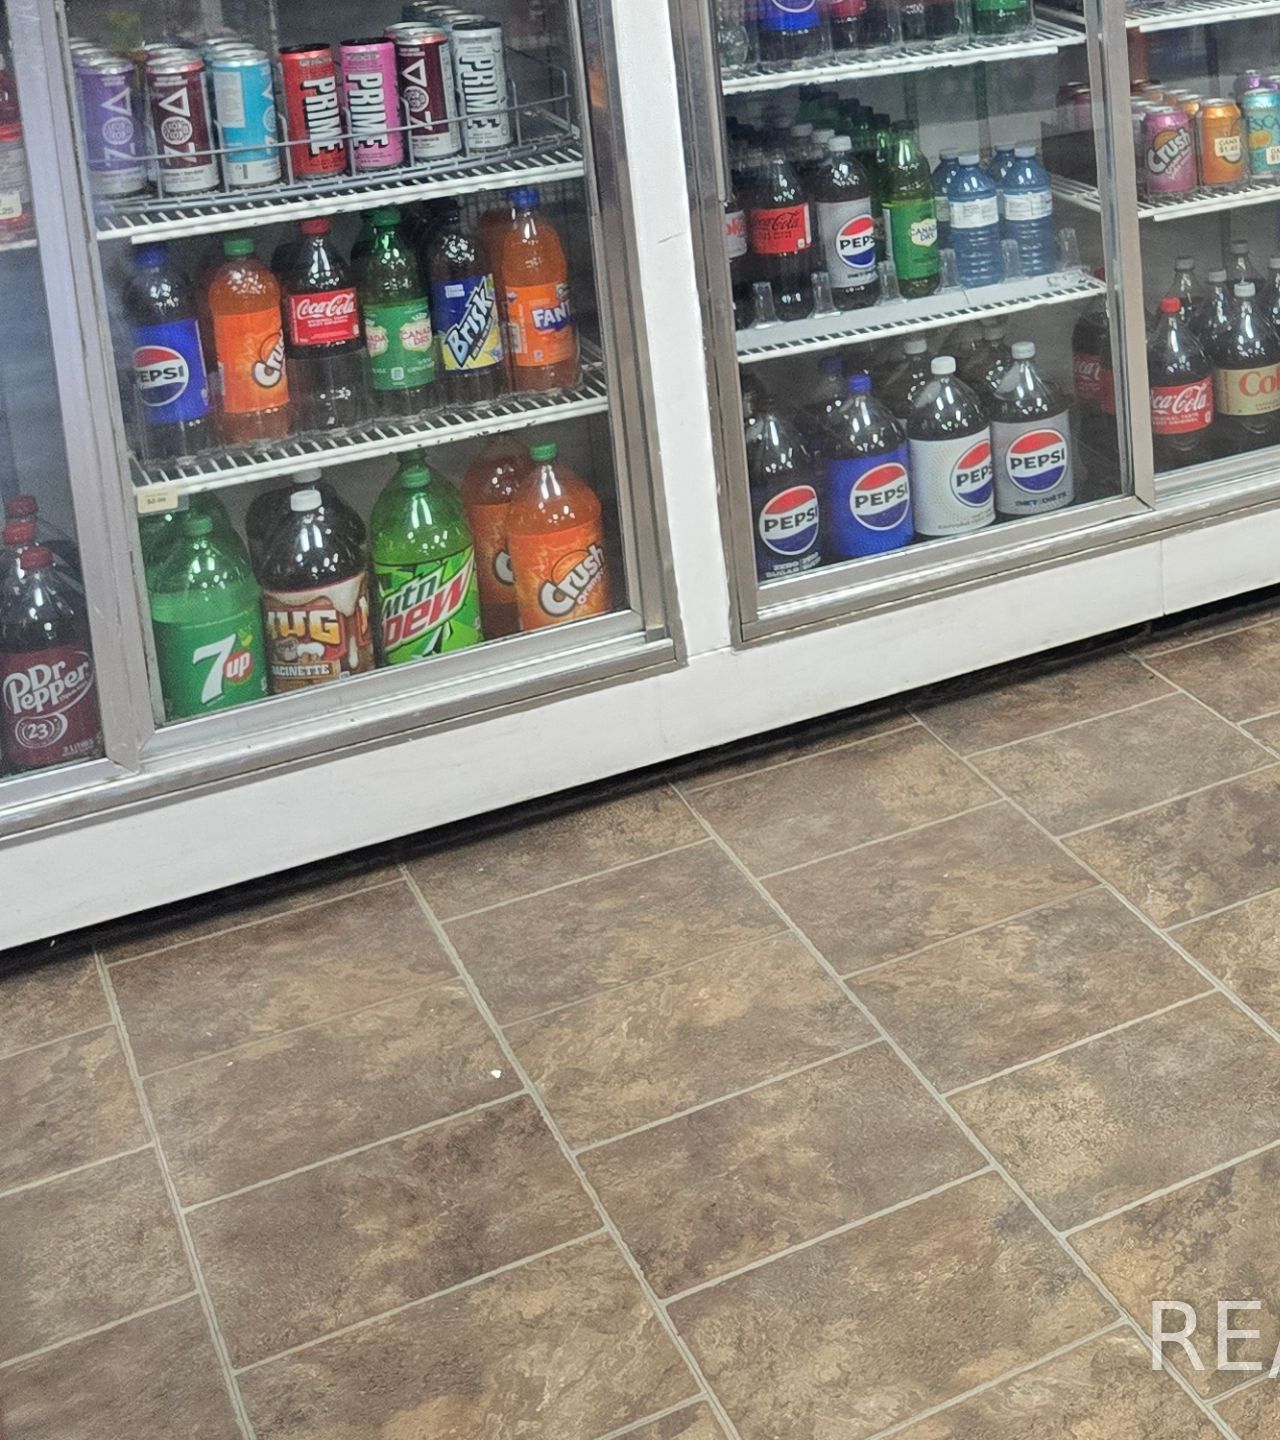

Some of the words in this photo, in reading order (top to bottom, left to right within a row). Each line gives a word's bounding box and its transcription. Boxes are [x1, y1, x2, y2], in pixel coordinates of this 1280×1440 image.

[302, 75, 344, 156] PRIME
[348, 71, 389, 149] PRIME
[297, 293, 357, 320] Coca-Cola
[1149, 385, 1209, 414] ca-Cola
[1010, 448, 1066, 470] PEPSI
[854, 482, 909, 508] PEPSI
[4, 661, 90, 714] Pepper
[29, 659, 67, 688] Dr
[27, 723, 49, 741] 23
